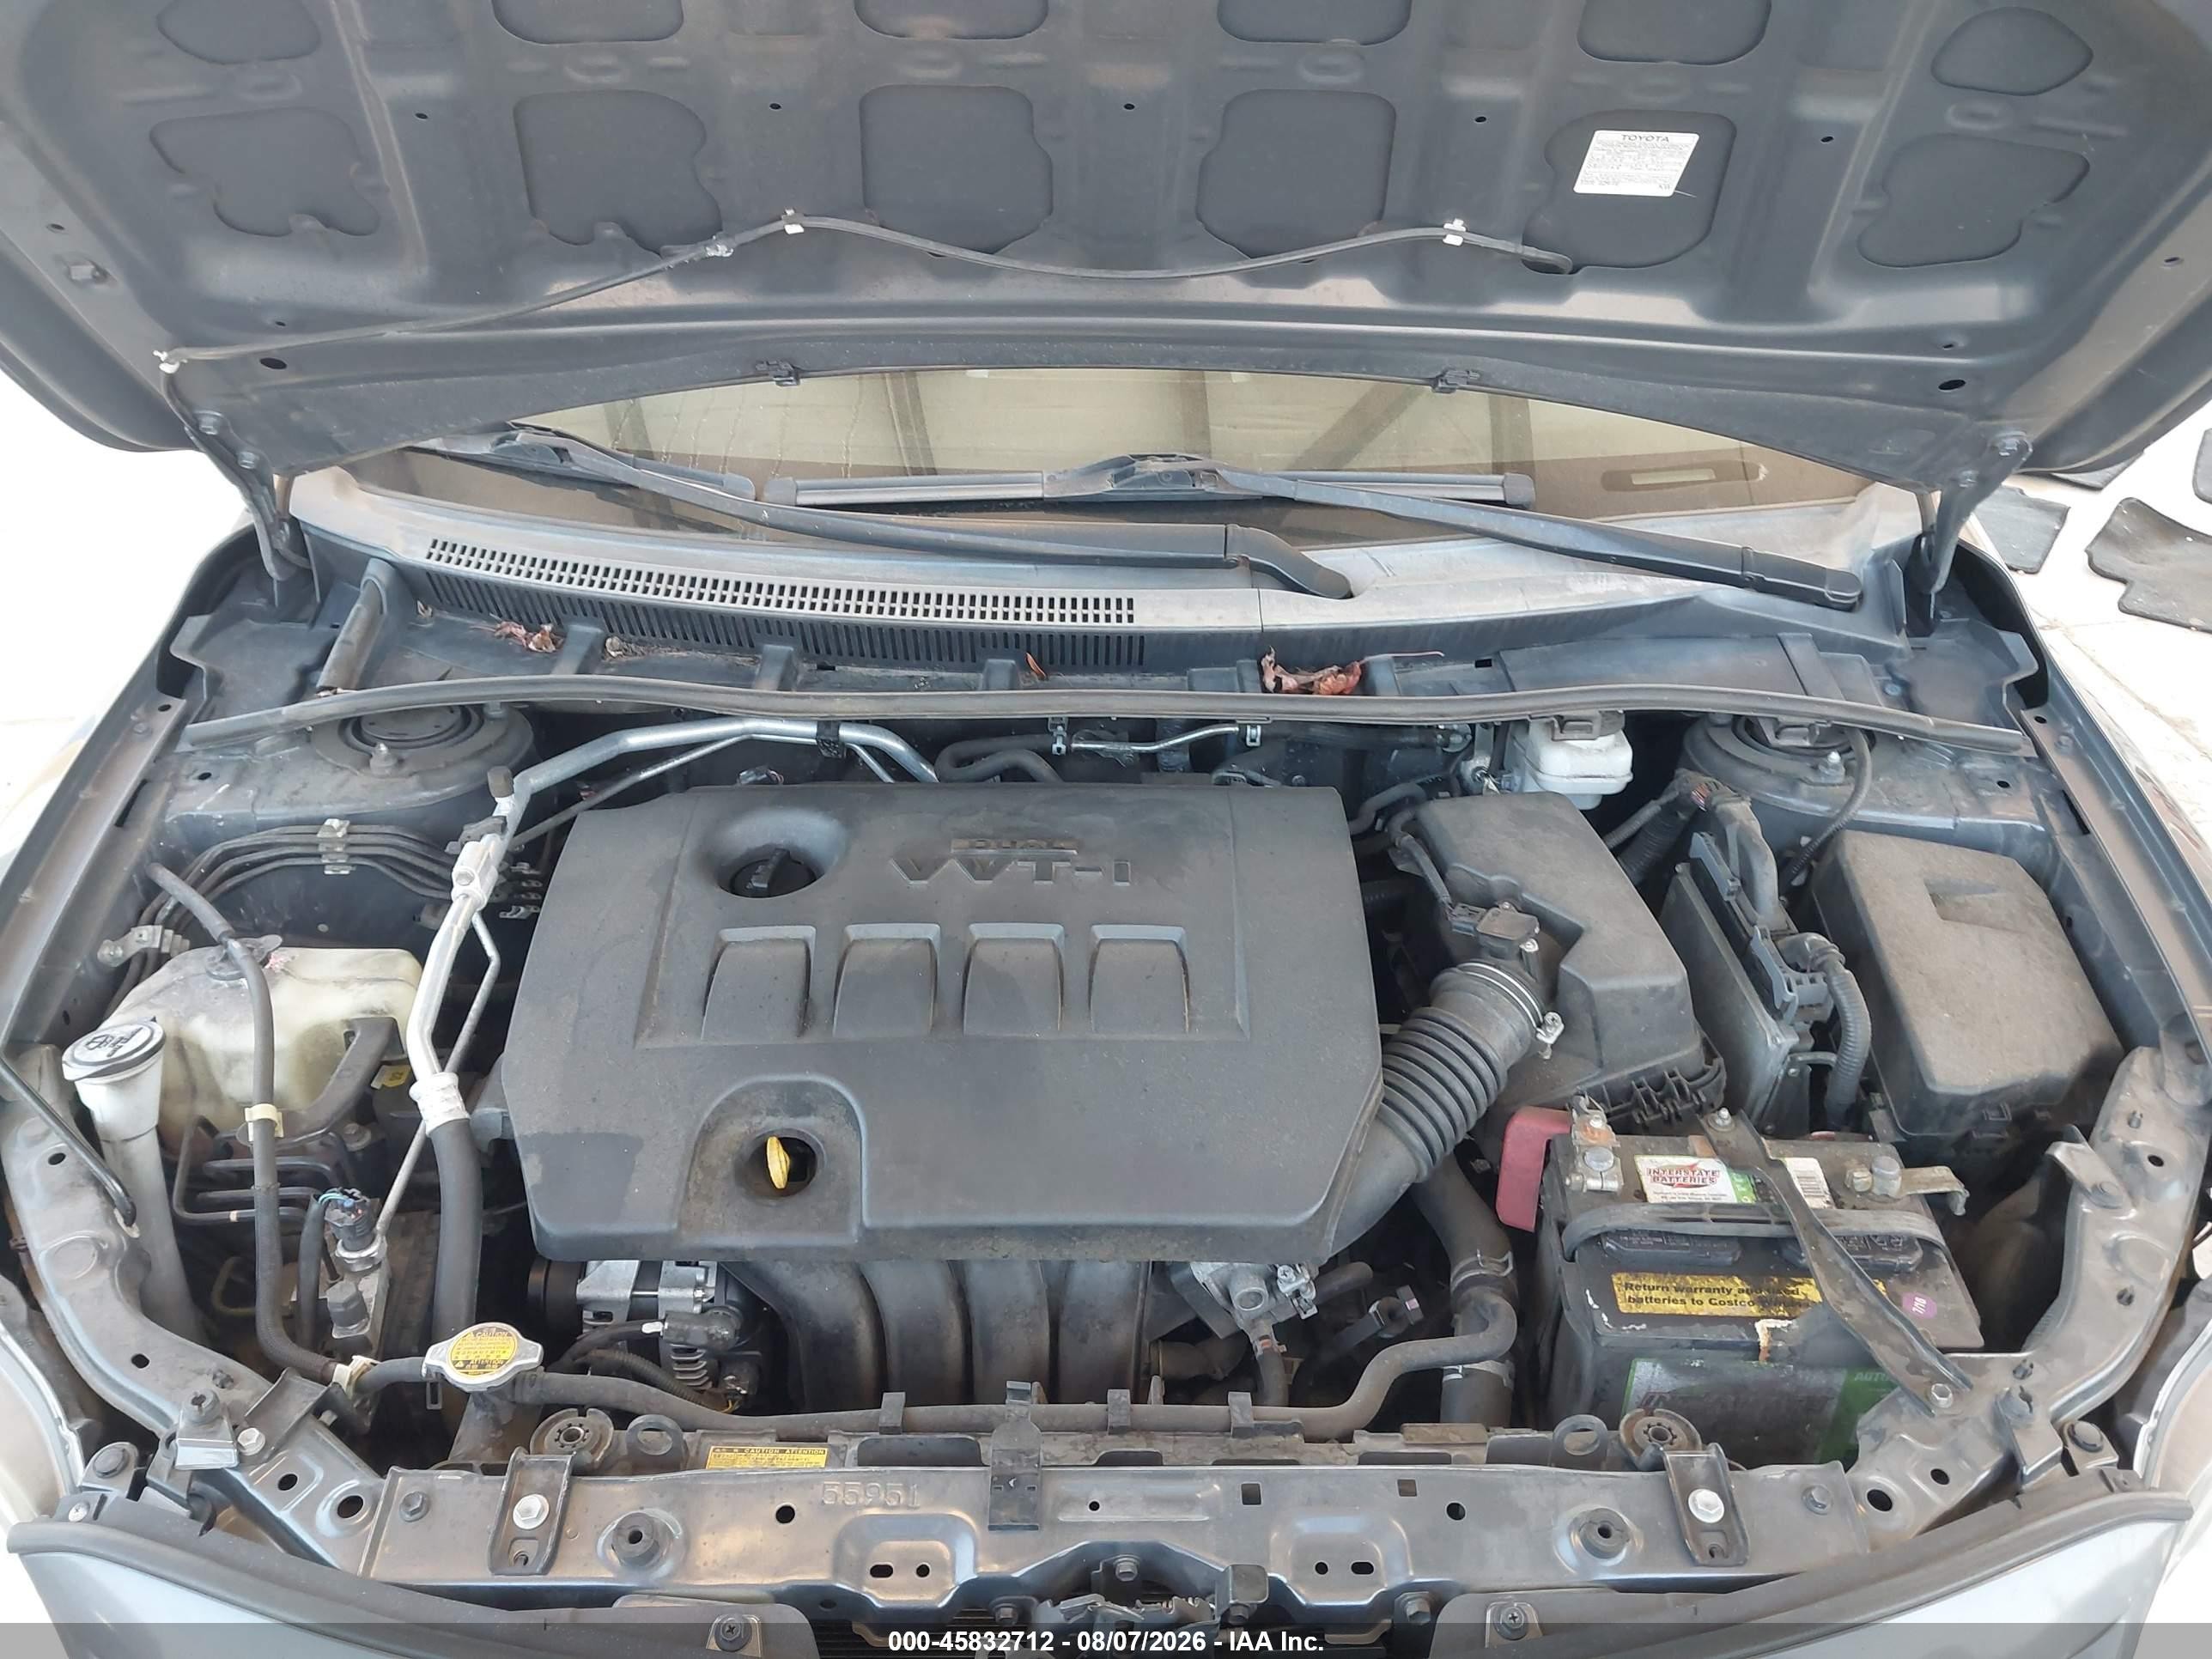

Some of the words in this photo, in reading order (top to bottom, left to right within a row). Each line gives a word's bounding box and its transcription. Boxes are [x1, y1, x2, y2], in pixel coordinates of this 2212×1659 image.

[1621, 134, 1669, 143] TOYOTA
[1646, 1167, 1720, 1177] INTERSTATE
[1650, 1175, 1718, 1184] BATTERIES
[1625, 1282, 1670, 1292] Return
[1672, 1283, 1733, 1296] warranty
[1768, 1286, 1800, 1296] ed
[1627, 1294, 1686, 1305] batteries
[1691, 1297, 1705, 1306] to
[1708, 1297, 1756, 1307] Costco
[822, 1481, 921, 1508] 55951
